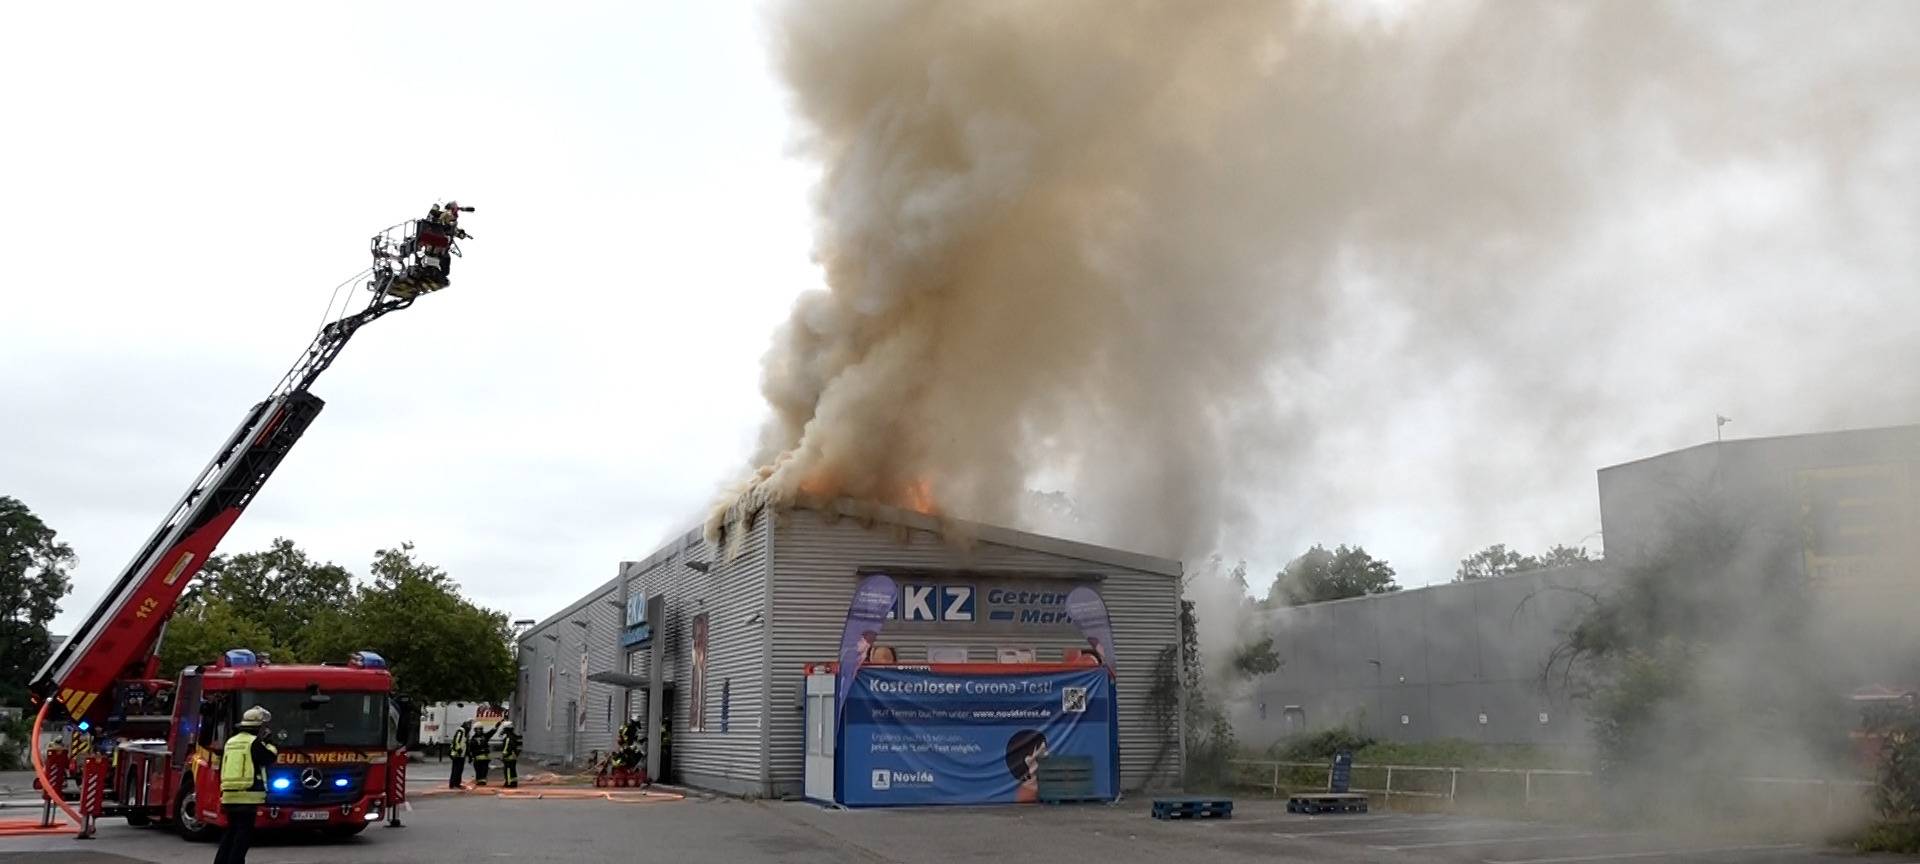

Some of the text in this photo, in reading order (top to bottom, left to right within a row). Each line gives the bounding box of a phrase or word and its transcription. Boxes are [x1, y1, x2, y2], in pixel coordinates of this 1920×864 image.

[136, 597, 159, 618] 112
[887, 586, 972, 621] KZ
[869, 679, 1053, 695] Kostenloser Corona-Test!
[973, 709, 1051, 718] www.novidatest.de
[893, 771, 934, 782] Novida
